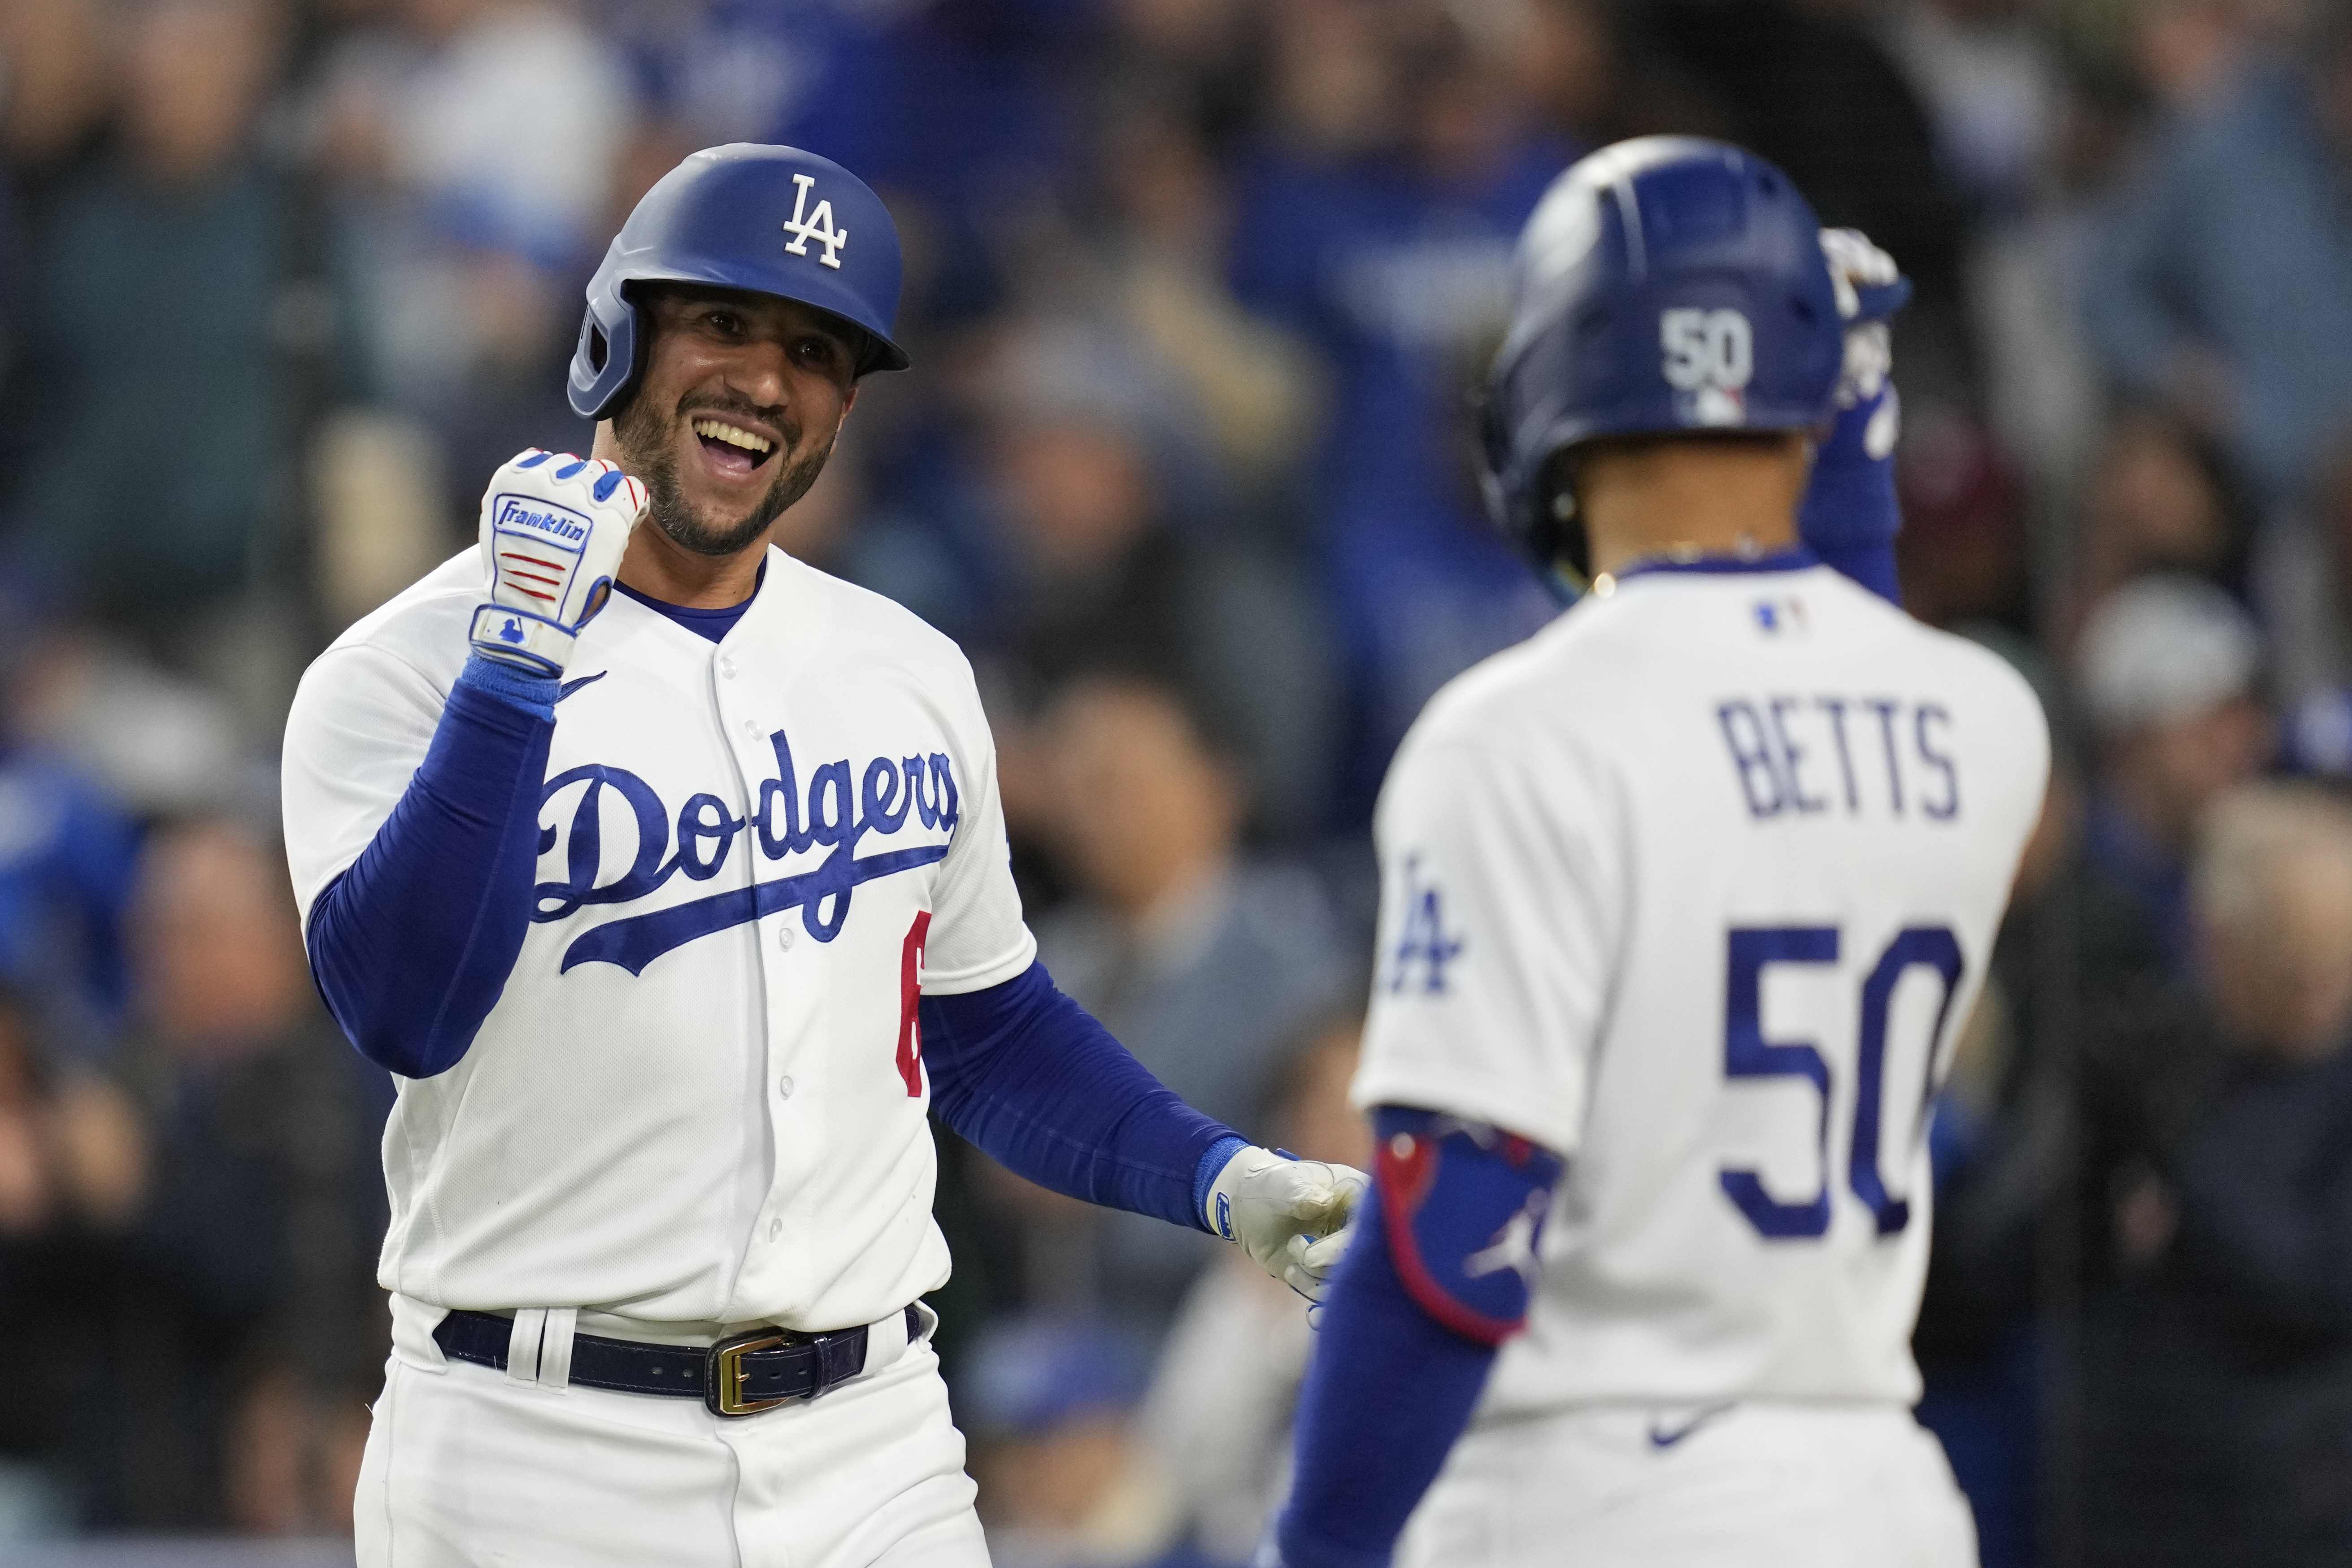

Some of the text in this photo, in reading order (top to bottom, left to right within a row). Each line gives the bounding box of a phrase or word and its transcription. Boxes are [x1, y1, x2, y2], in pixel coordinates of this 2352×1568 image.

[783, 173, 848, 269] LA
[1661, 308, 1753, 391] 50
[1717, 697, 1959, 820] BETTS
[530, 729, 958, 943] Dodgers
[1720, 925, 1964, 1237] 50
